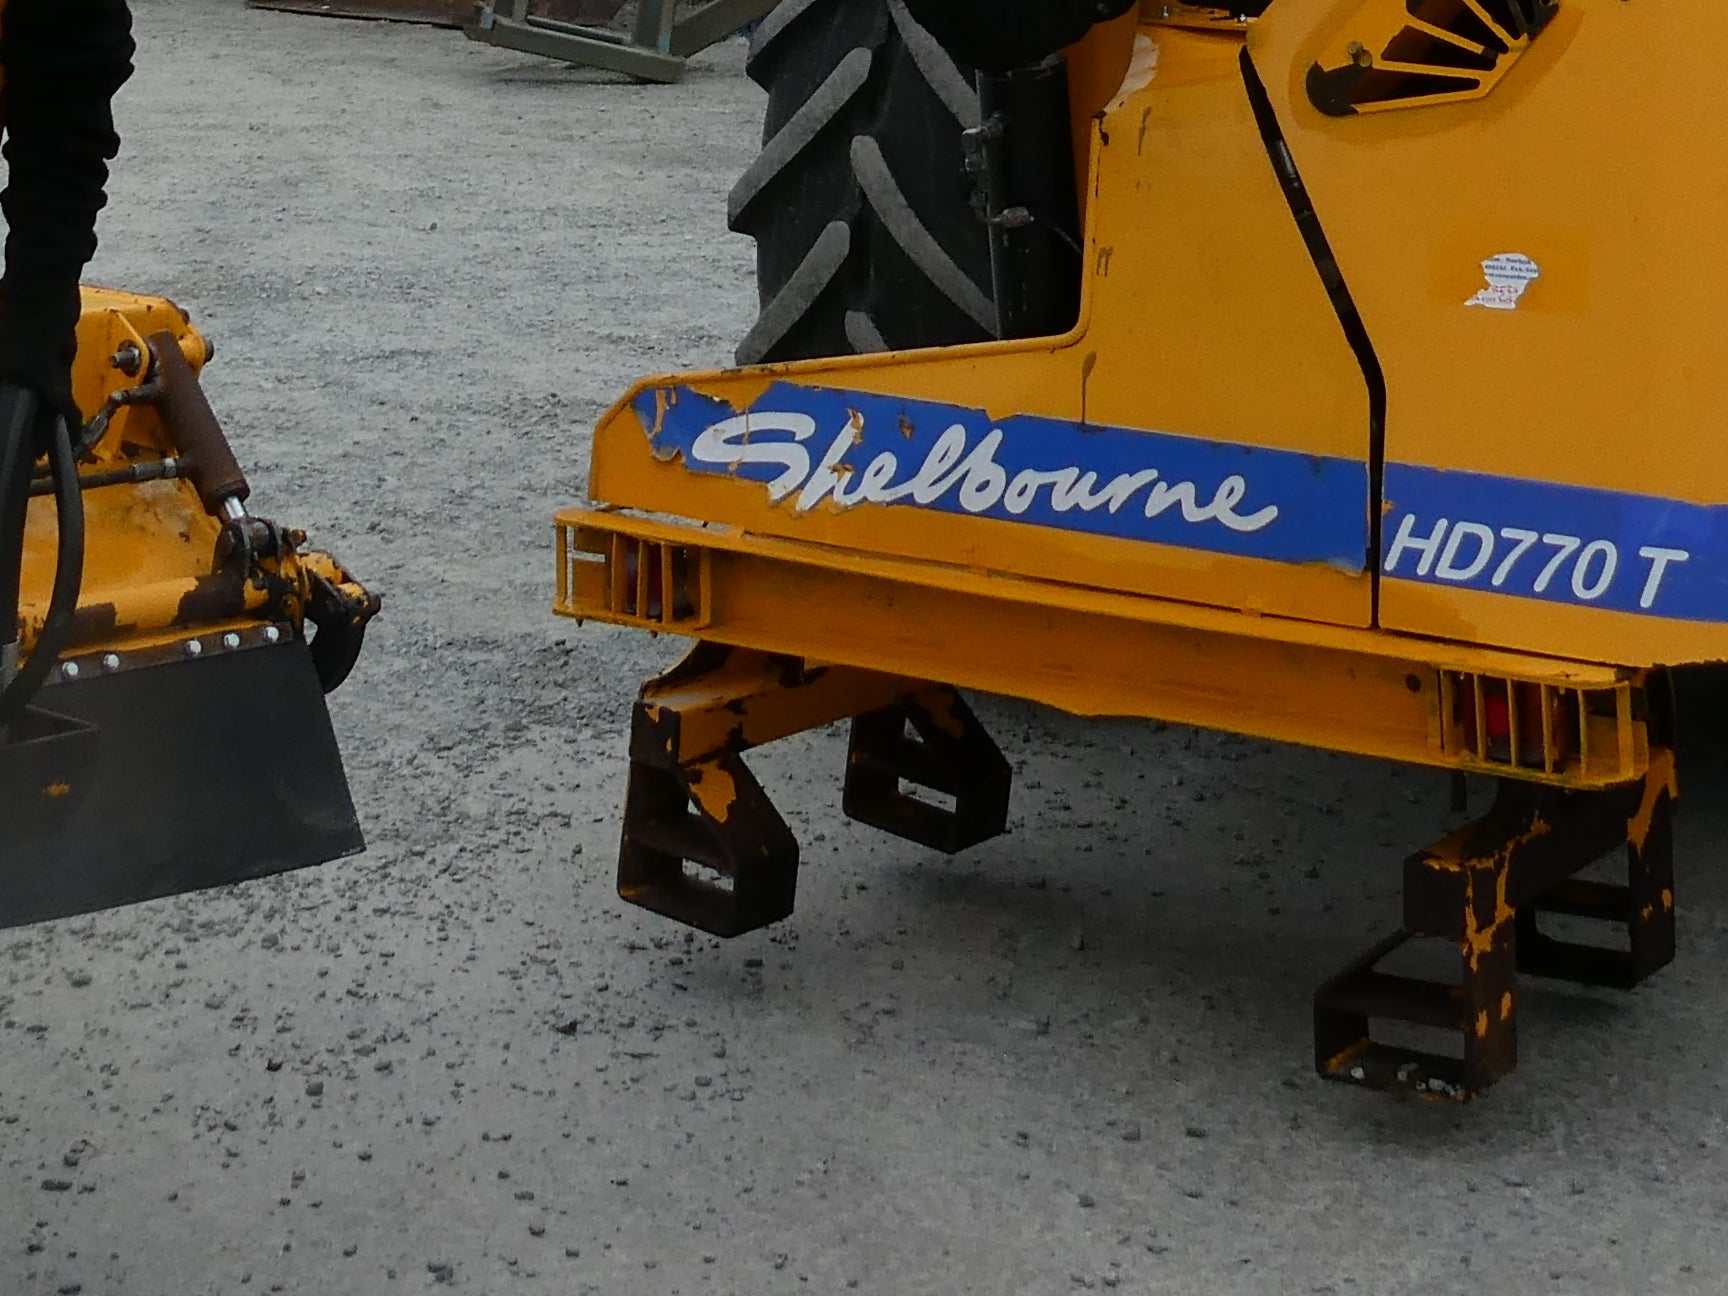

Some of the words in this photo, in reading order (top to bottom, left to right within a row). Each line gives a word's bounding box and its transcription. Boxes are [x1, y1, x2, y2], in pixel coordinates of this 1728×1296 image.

[690, 411, 1279, 533] Shelbourne
[1383, 513, 1618, 600] HD770
[1638, 545, 1690, 609] T
